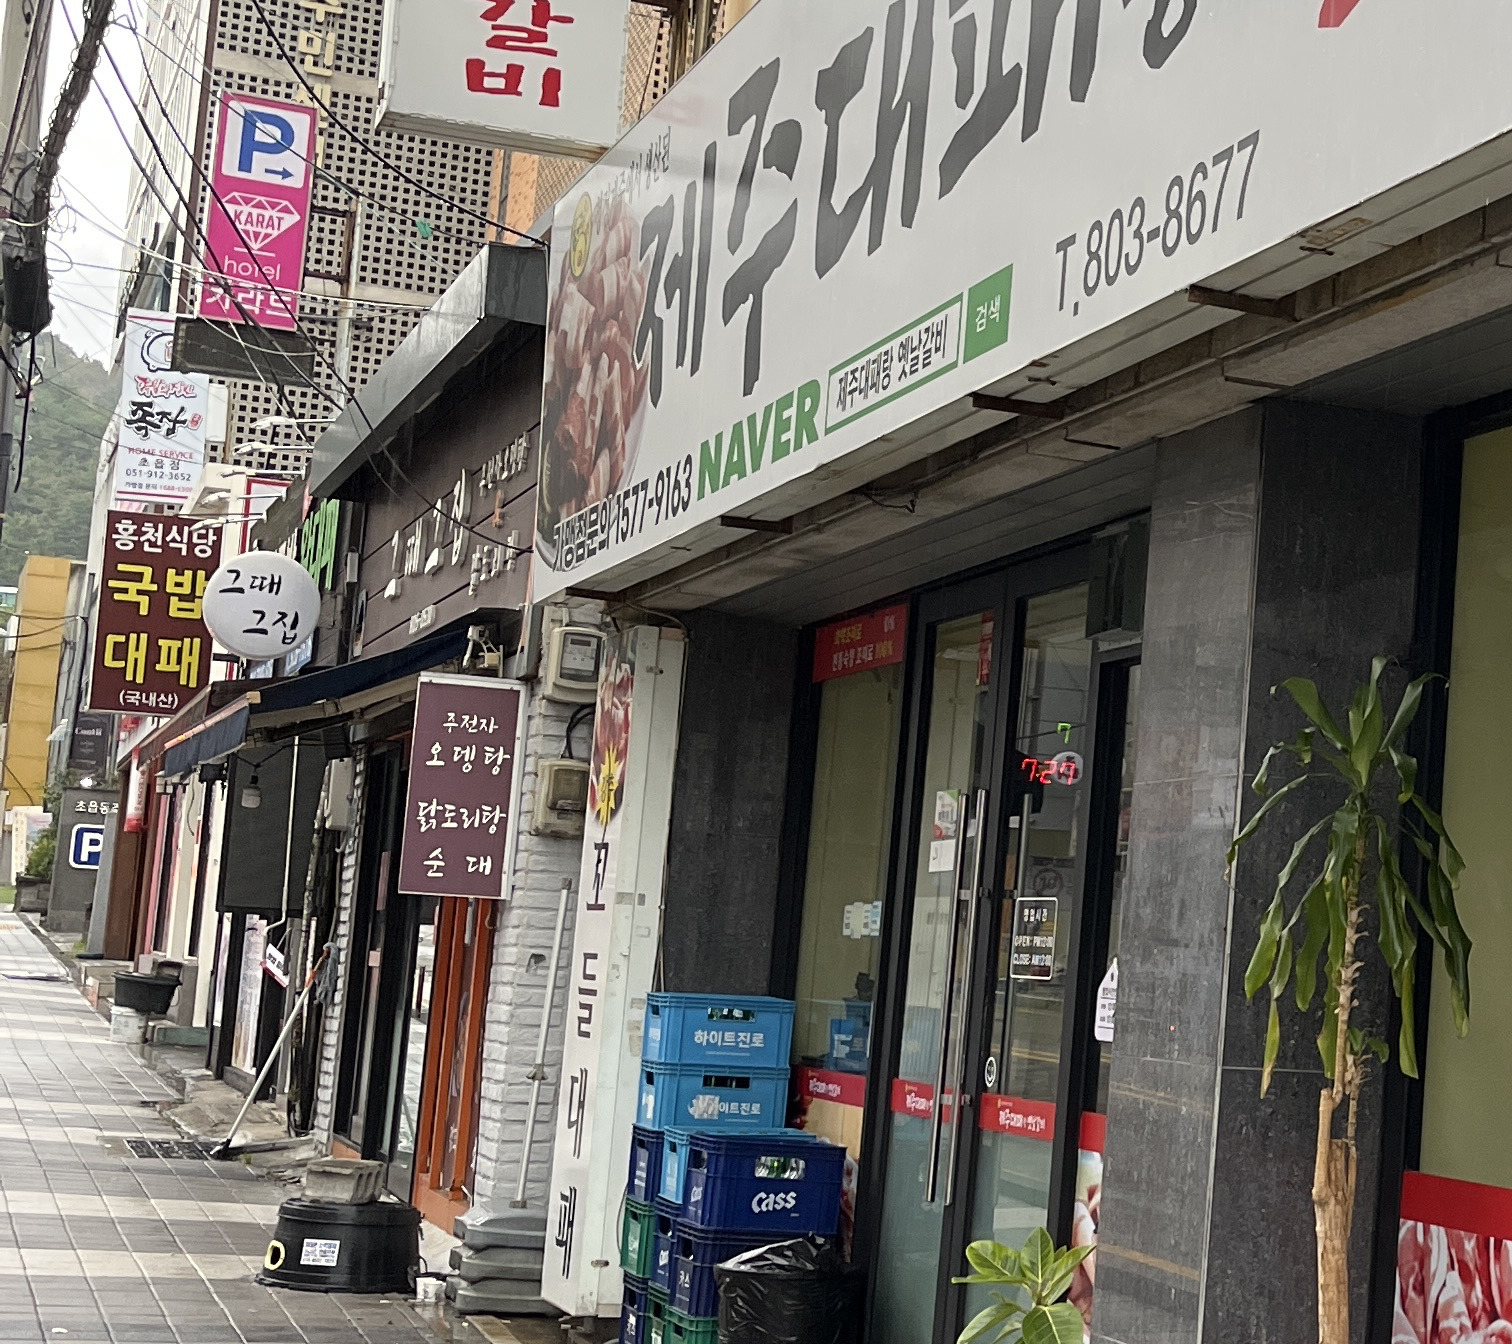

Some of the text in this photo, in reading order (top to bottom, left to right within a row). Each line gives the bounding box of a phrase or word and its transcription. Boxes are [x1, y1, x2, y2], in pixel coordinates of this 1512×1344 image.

[238, 110, 295, 173] P
[233, 209, 285, 232] KARAT
[1055, 129, 1261, 317] T.803-8677
[223, 255, 281, 281] hotel
[974, 294, 1001, 333] 검색
[836, 314, 948, 412] 제주대패랑 옛날갈비
[697, 379, 821, 502] NAVER
[614, 453, 693, 545] 1577-9163
[111, 519, 217, 558] 홍천식당
[107, 562, 210, 619] 국밥
[219, 569, 282, 596] 그때
[242, 609, 300, 645] 그집
[103, 632, 202, 688] 대패
[118, 689, 179, 710] (국내산)
[443, 712, 499, 733] 주전자
[425, 742, 510, 775] 오뎅탕
[417, 798, 507, 834] 닭도리탕
[80, 831, 105, 862] P
[423, 847, 493, 878] 순대
[693, 1029, 765, 1048] 하이트진로
[751, 1191, 797, 1214] Cass
